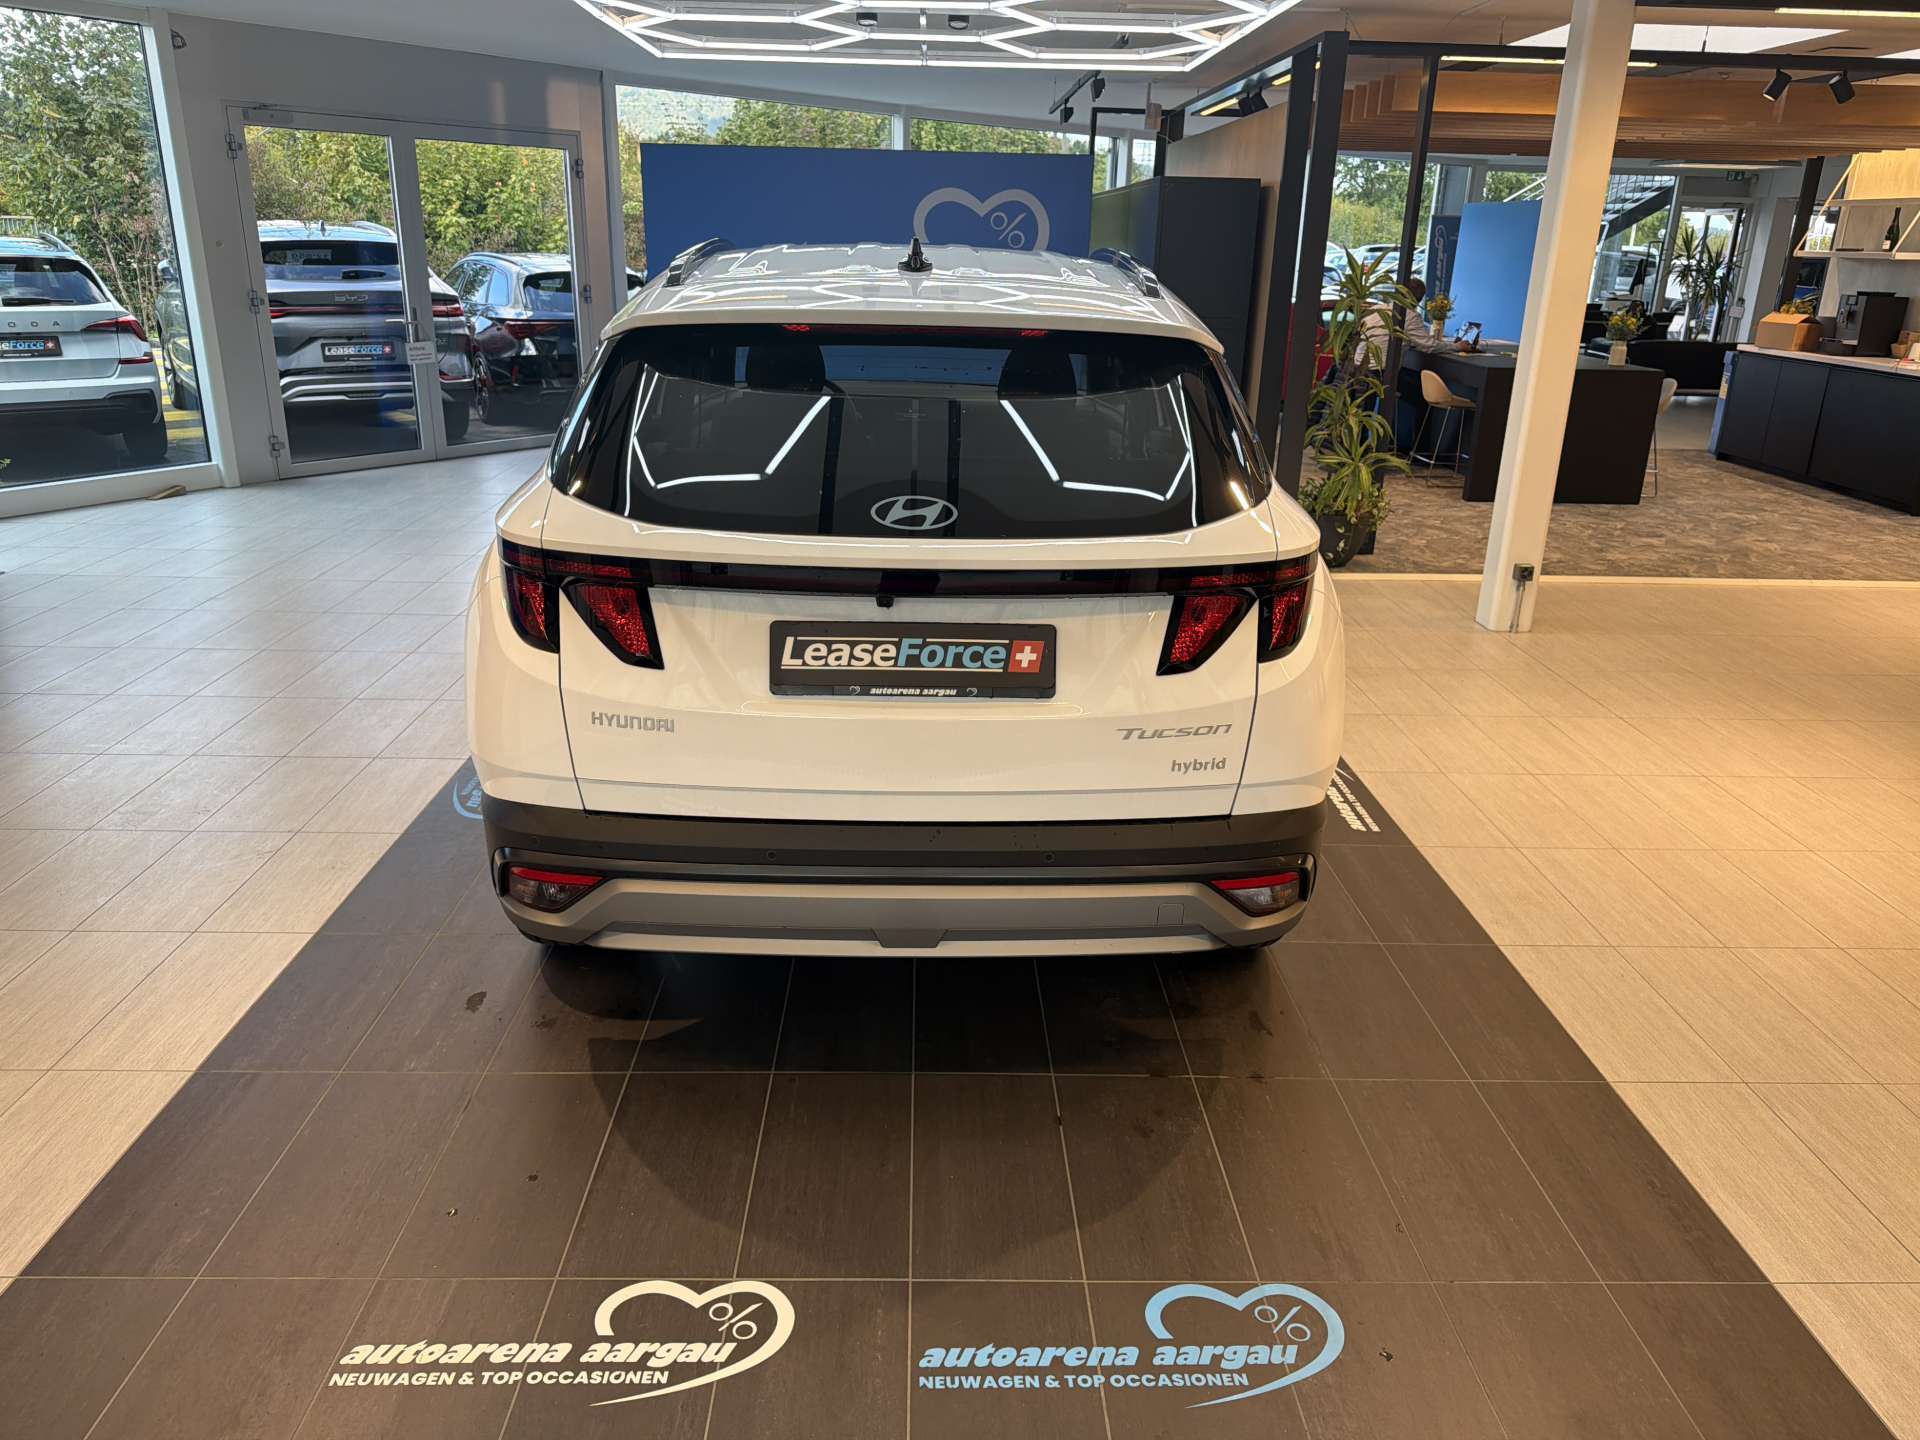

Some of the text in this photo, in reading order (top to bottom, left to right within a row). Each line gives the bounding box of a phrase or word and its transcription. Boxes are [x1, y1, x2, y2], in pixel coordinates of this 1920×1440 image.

[0, 340, 44, 350] eForce
[325, 345, 384, 355] LeaseForce
[781, 636, 1007, 669] LeaseForce
[870, 687, 957, 696] autoarena aargau
[591, 711, 675, 733] HYUNDAI
[1170, 757, 1227, 775] hybrid
[338, 1339, 738, 1368] autoarena aargau
[918, 1343, 1299, 1370] autoarena aargau
[327, 1370, 670, 1387] NEUWAGEN & TOP OCCASIONEN
[919, 1373, 1250, 1390] NEUWAGEN & TOP OCCASIONEN
